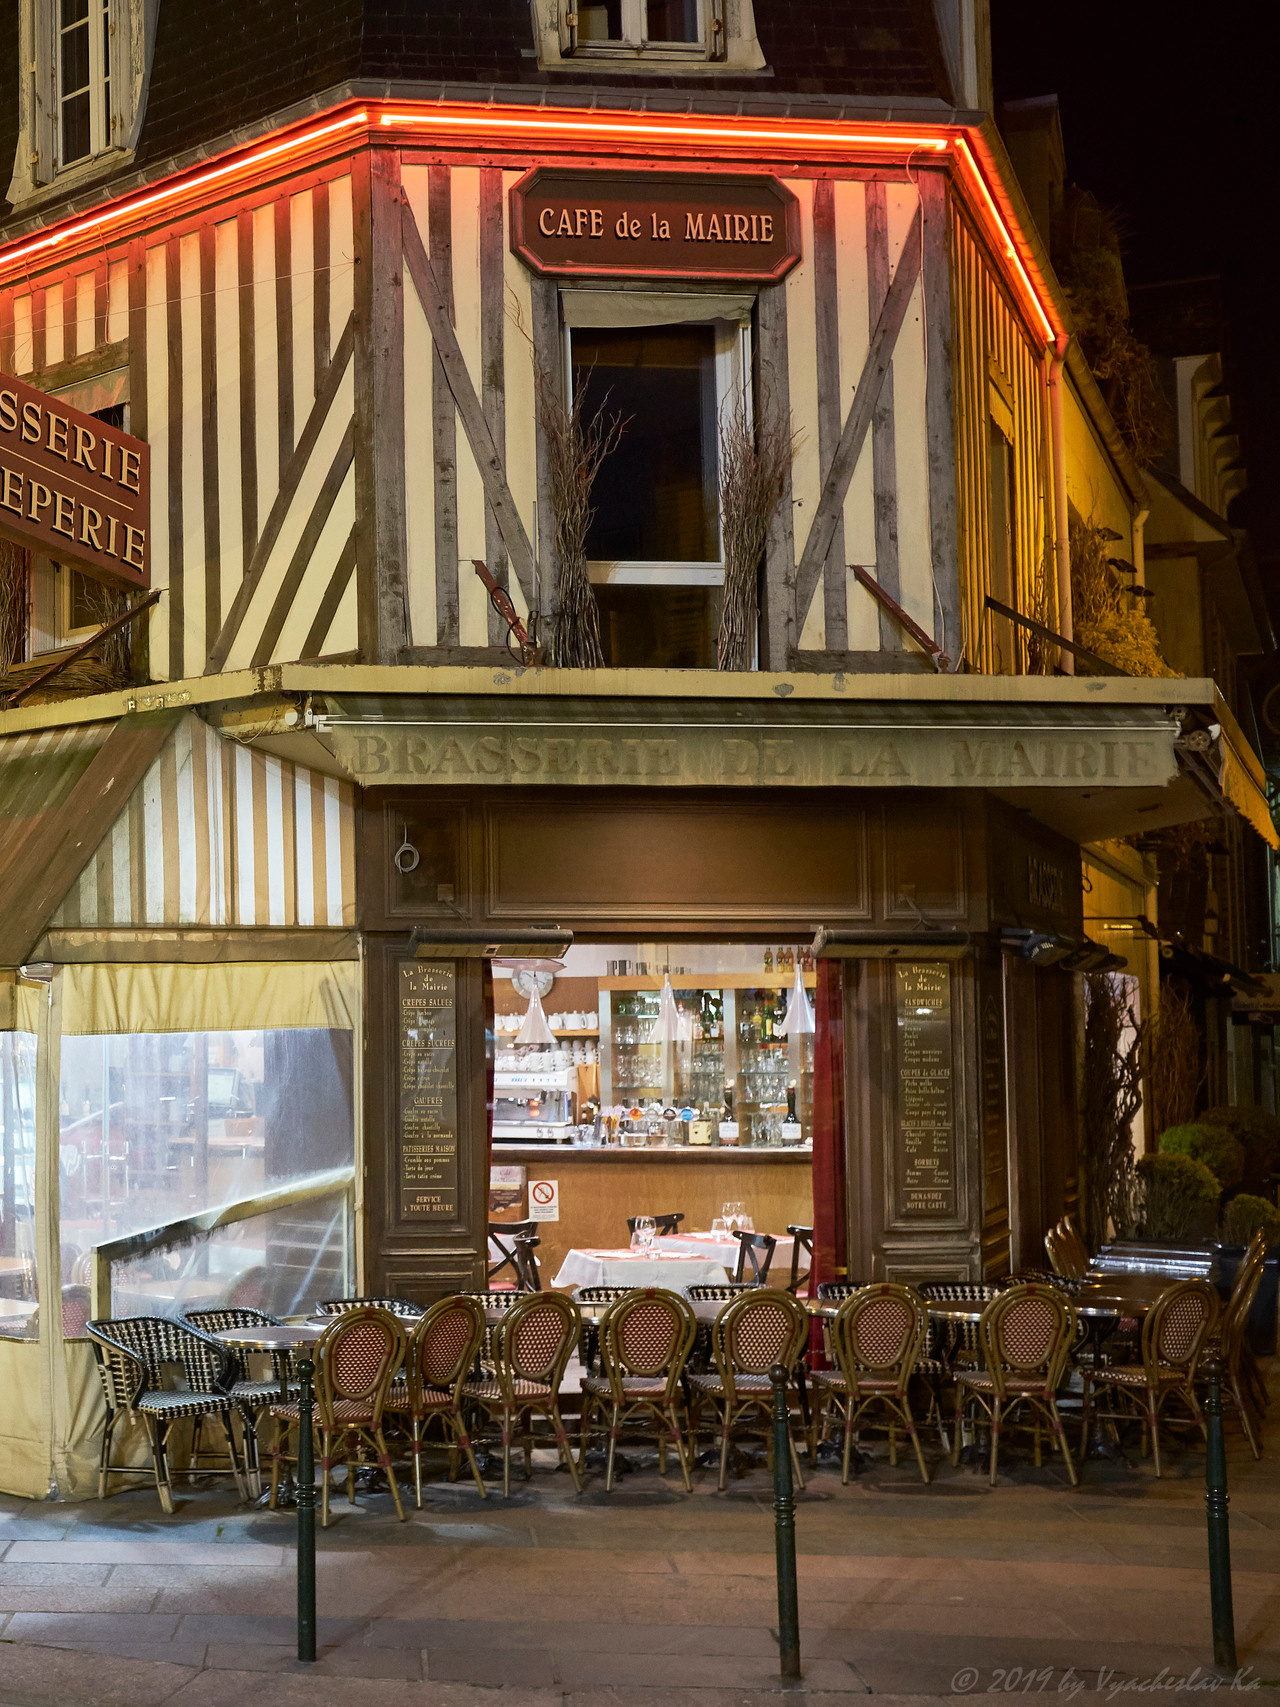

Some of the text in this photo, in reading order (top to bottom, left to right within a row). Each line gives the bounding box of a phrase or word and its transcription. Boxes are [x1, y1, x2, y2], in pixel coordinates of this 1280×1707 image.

[539, 207, 774, 242] CAFE de la MAIRIE
[353, 735, 1160, 779] BRASSERIE DE LA MAIRIE
[403, 965, 453, 978] La Brasserie
[423, 974, 433, 982] de
[918, 974, 927, 982] de
[410, 981, 448, 991] la Mairie
[904, 982, 942, 991] la Mairie
[904, 998, 943, 1006] SANDWICHES
[414, 1096, 443, 1104] GAUFRES
[910, 1192, 942, 1200] DEMANDEZ
[410, 1204, 431, 1212] TOUTE
[432, 1204, 453, 1212] HEURE
[906, 1201, 946, 1209] NOTRE CARTE
